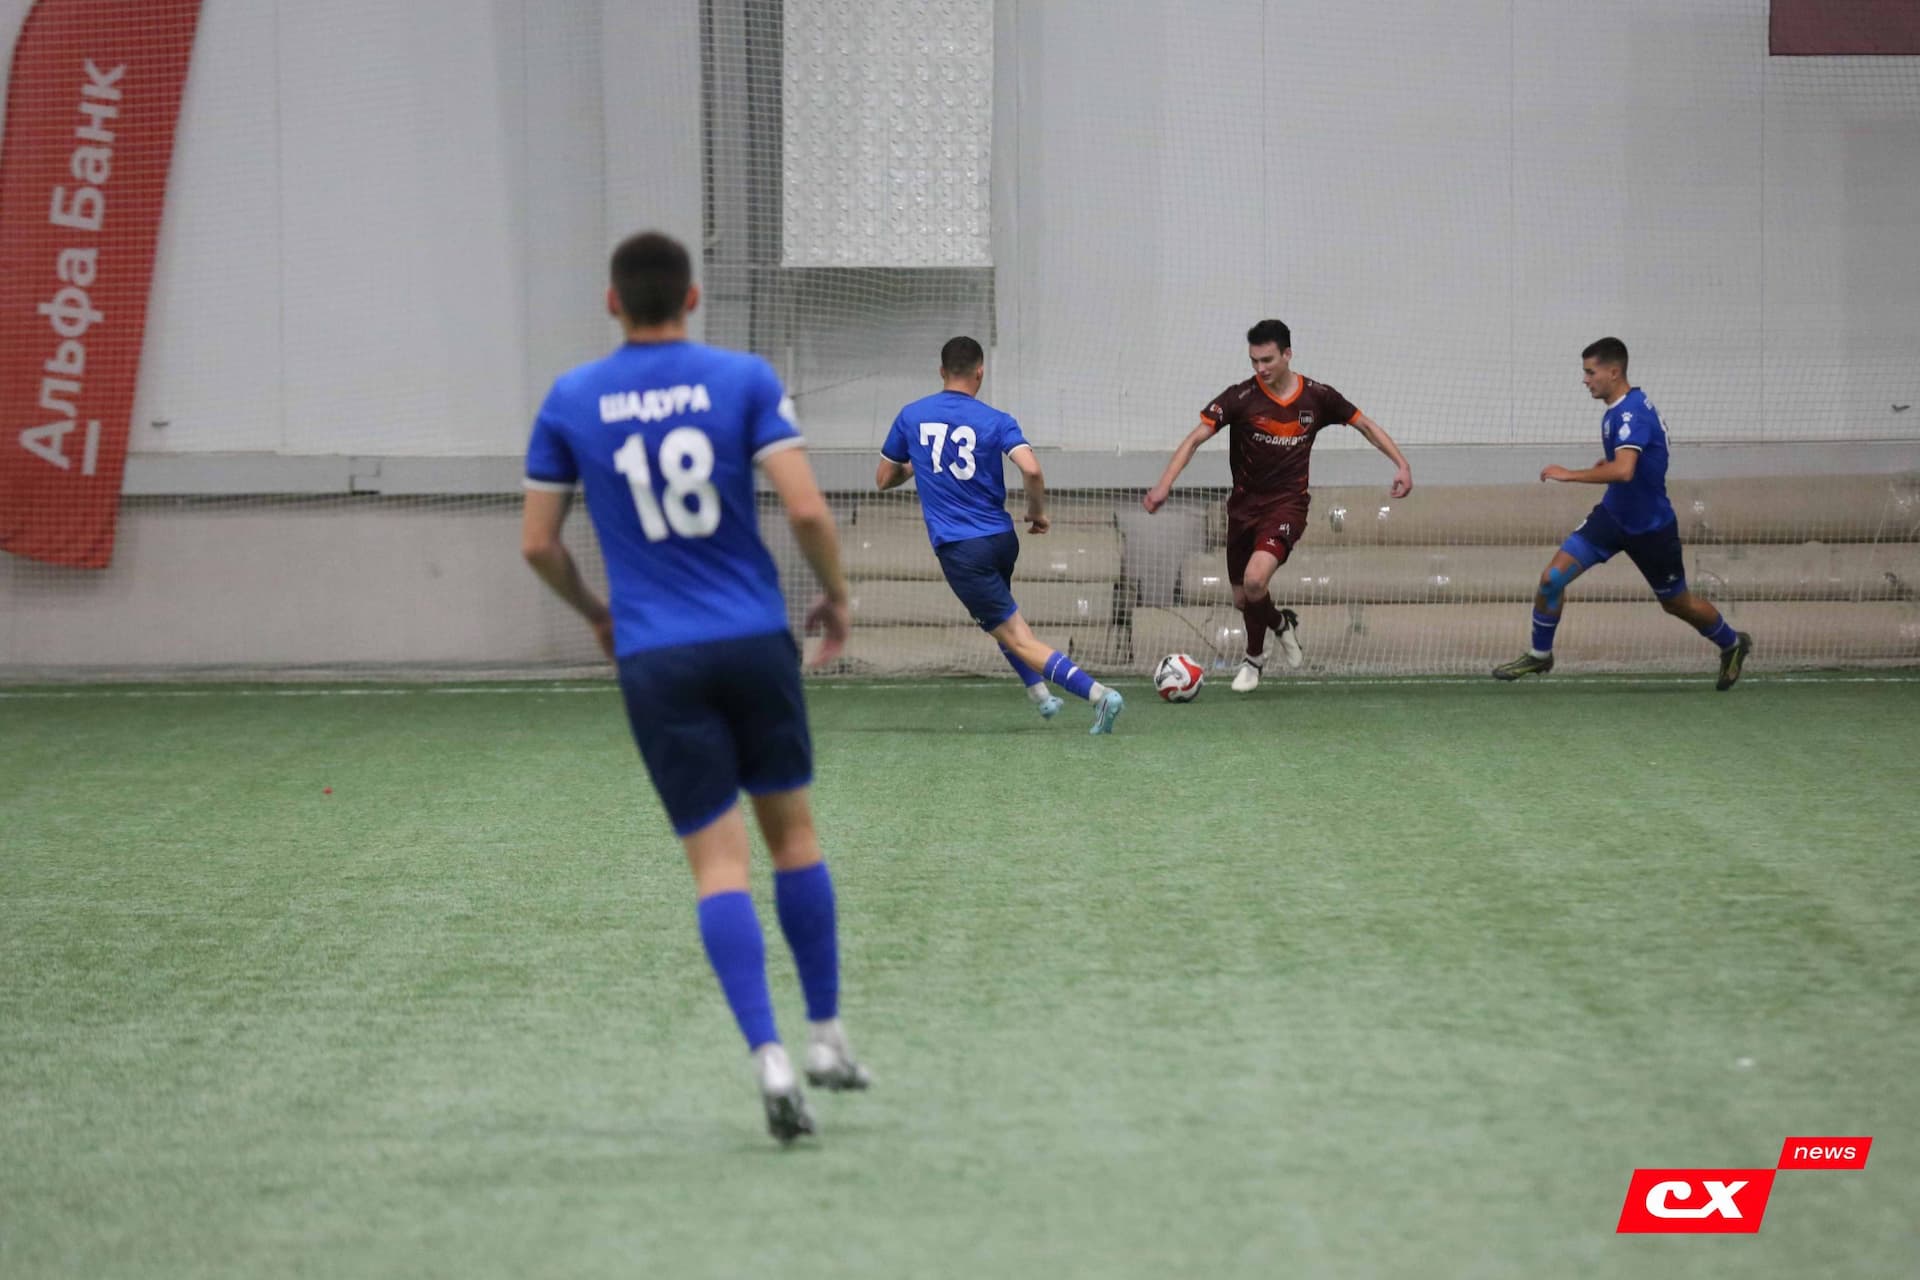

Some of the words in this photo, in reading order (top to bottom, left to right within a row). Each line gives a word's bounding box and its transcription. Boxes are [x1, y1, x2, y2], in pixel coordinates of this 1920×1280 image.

[50, 58, 127, 231] Банк
[19, 247, 105, 470] Альфа
[600, 384, 711, 423] ШАДУРА
[613, 426, 721, 542] 18
[919, 422, 977, 481] 73
